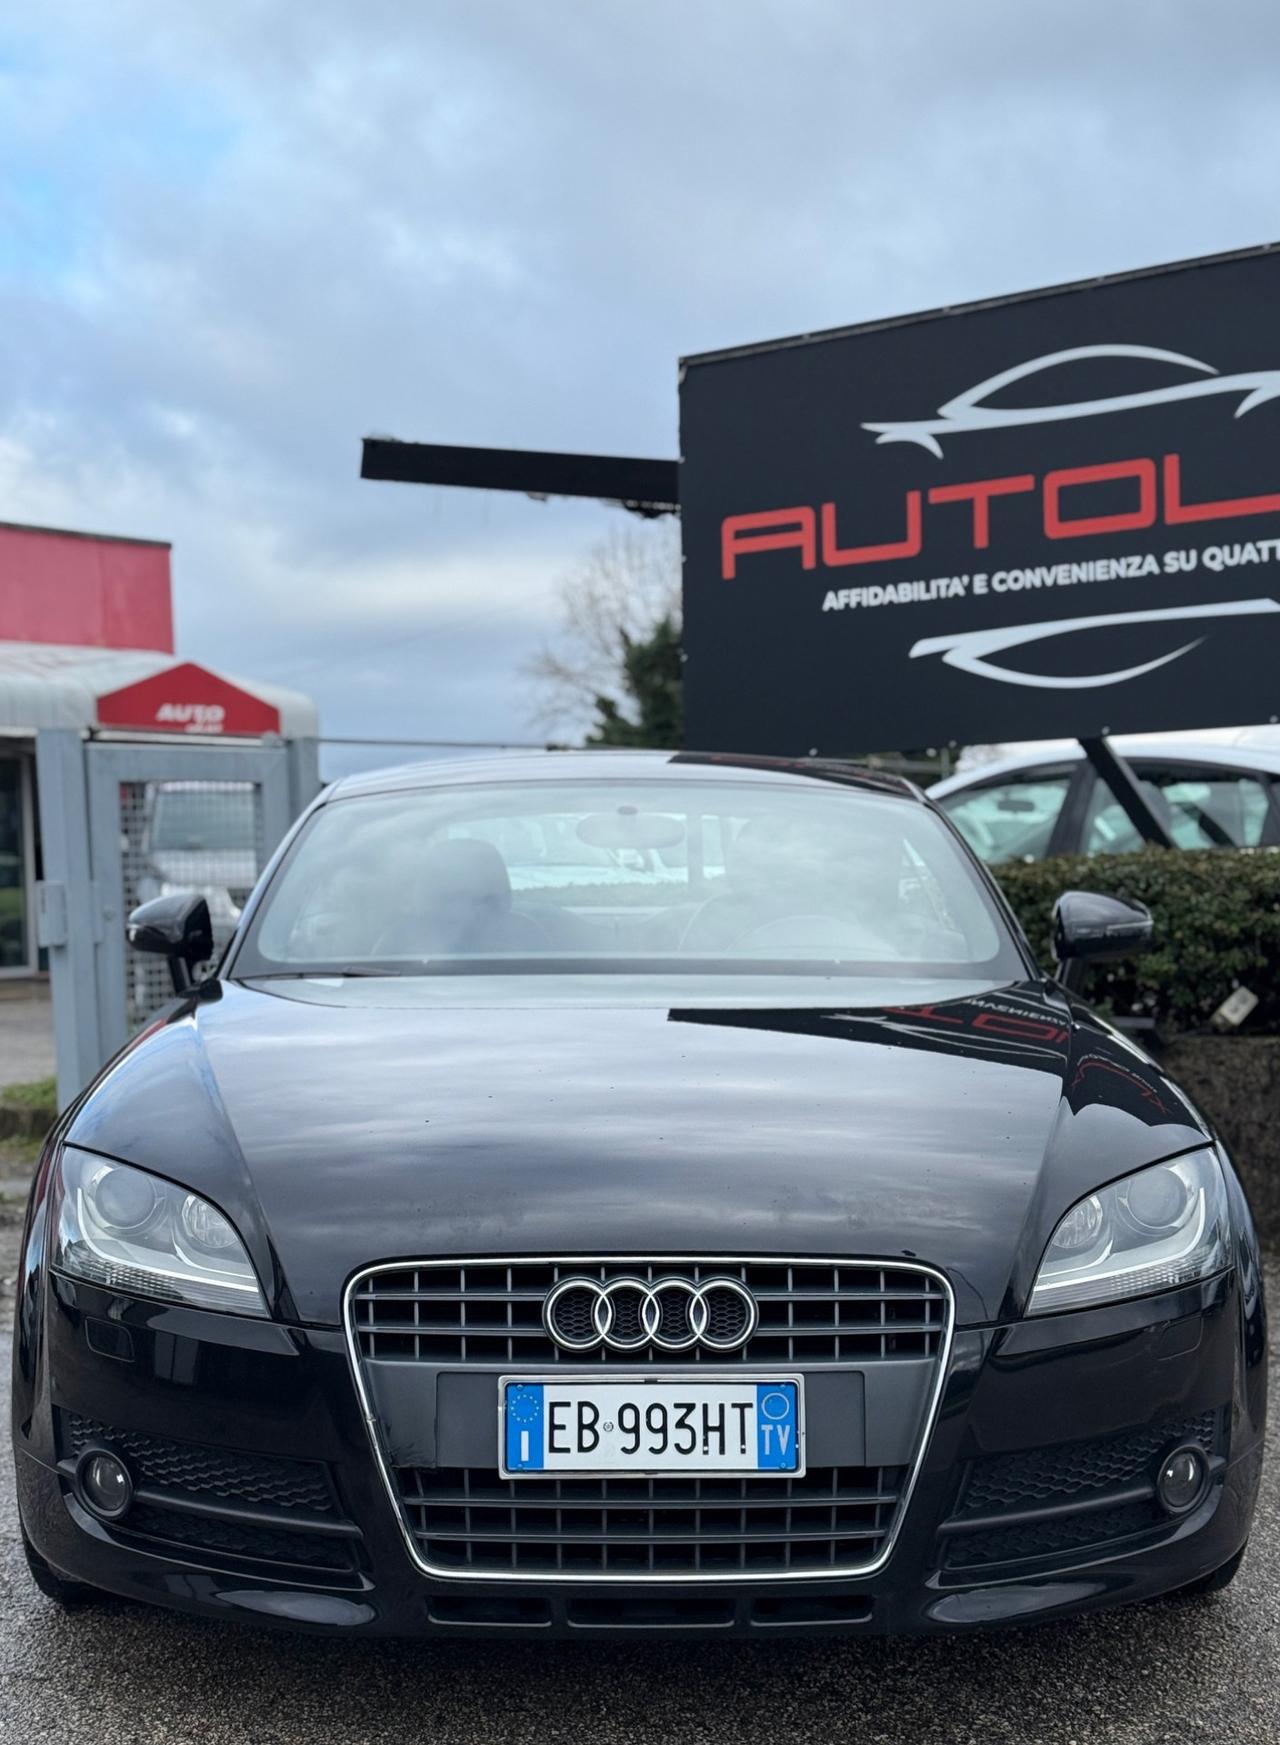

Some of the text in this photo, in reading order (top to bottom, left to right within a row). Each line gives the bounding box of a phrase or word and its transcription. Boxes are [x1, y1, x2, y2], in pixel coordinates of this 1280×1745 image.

[822, 575, 969, 612] AFFIDABILITA'
[973, 573, 989, 595] E
[991, 554, 1160, 593] CONVENIENZA
[1163, 549, 1198, 574] SU
[156, 702, 226, 723] AUTO
[548, 1400, 600, 1454] EB
[617, 1402, 754, 1456] 993HT
[761, 1424, 790, 1456] TV
